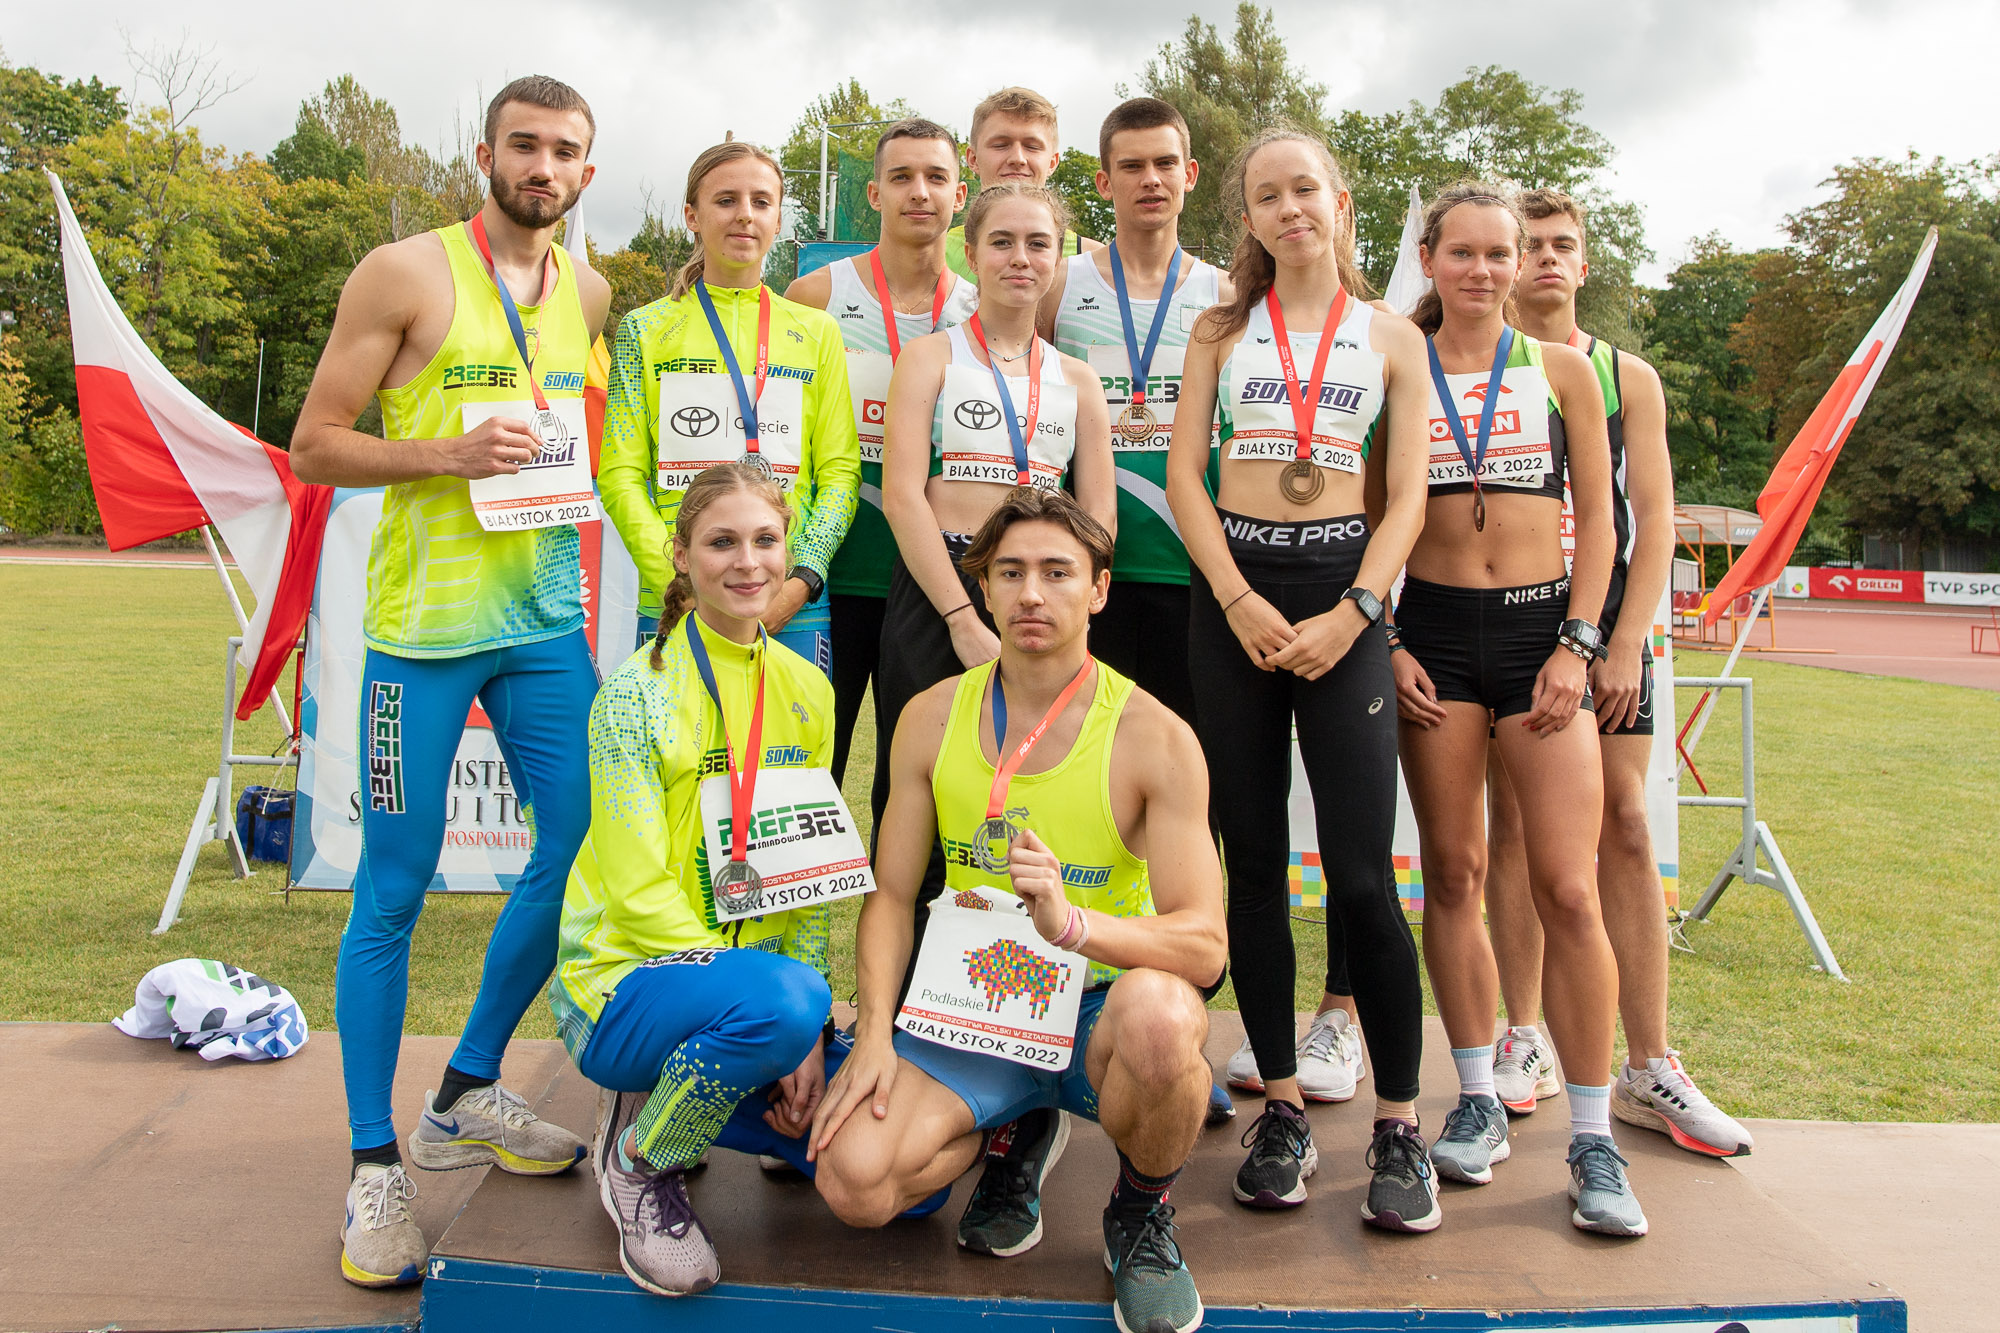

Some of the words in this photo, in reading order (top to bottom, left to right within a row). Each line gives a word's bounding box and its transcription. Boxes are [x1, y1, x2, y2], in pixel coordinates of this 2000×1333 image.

[1077, 303, 1100, 311] erima
[543, 371, 585, 392] SONA
[1284, 360, 1295, 382] PZLA
[1240, 378, 1366, 413] SONROL
[734, 416, 789, 434] Oęcie
[1015, 415, 1065, 437] Oęcie
[1430, 413, 1516, 439] OLN
[1323, 449, 1354, 468] 2022
[1428, 461, 1498, 479] AŁYSTOK
[1503, 457, 1544, 473] 2022
[949, 465, 1018, 482] BIAŁYSTO
[485, 509, 554, 527] BIAŁYSTOK
[558, 505, 591, 520] 2022
[1223, 516, 1295, 546] NIKE
[1298, 519, 1366, 546] PRO
[1504, 586, 1552, 605] NIKE
[1859, 580, 1901, 590] ORLEN
[1927, 581, 1964, 594] TVP
[1019, 735, 1036, 757] PZLA
[447, 830, 533, 850] POSPOLITEJ
[794, 868, 820, 880] POLSKI
[820, 866, 828, 874] W
[1060, 862, 1115, 888] NAROL
[727, 882, 825, 915] ŁYSTOK
[829, 873, 867, 894] 2022
[921, 988, 984, 1011] Podlaskie
[906, 1008, 926, 1017] PZLA
[927, 1013, 983, 1030] MISTRZOSTWA
[984, 1024, 1012, 1035] POLSKI
[1022, 1032, 1069, 1045] SZTAFETACH
[905, 1019, 1009, 1053] BIAŁYSTOK
[1013, 1044, 1060, 1065] 2022
